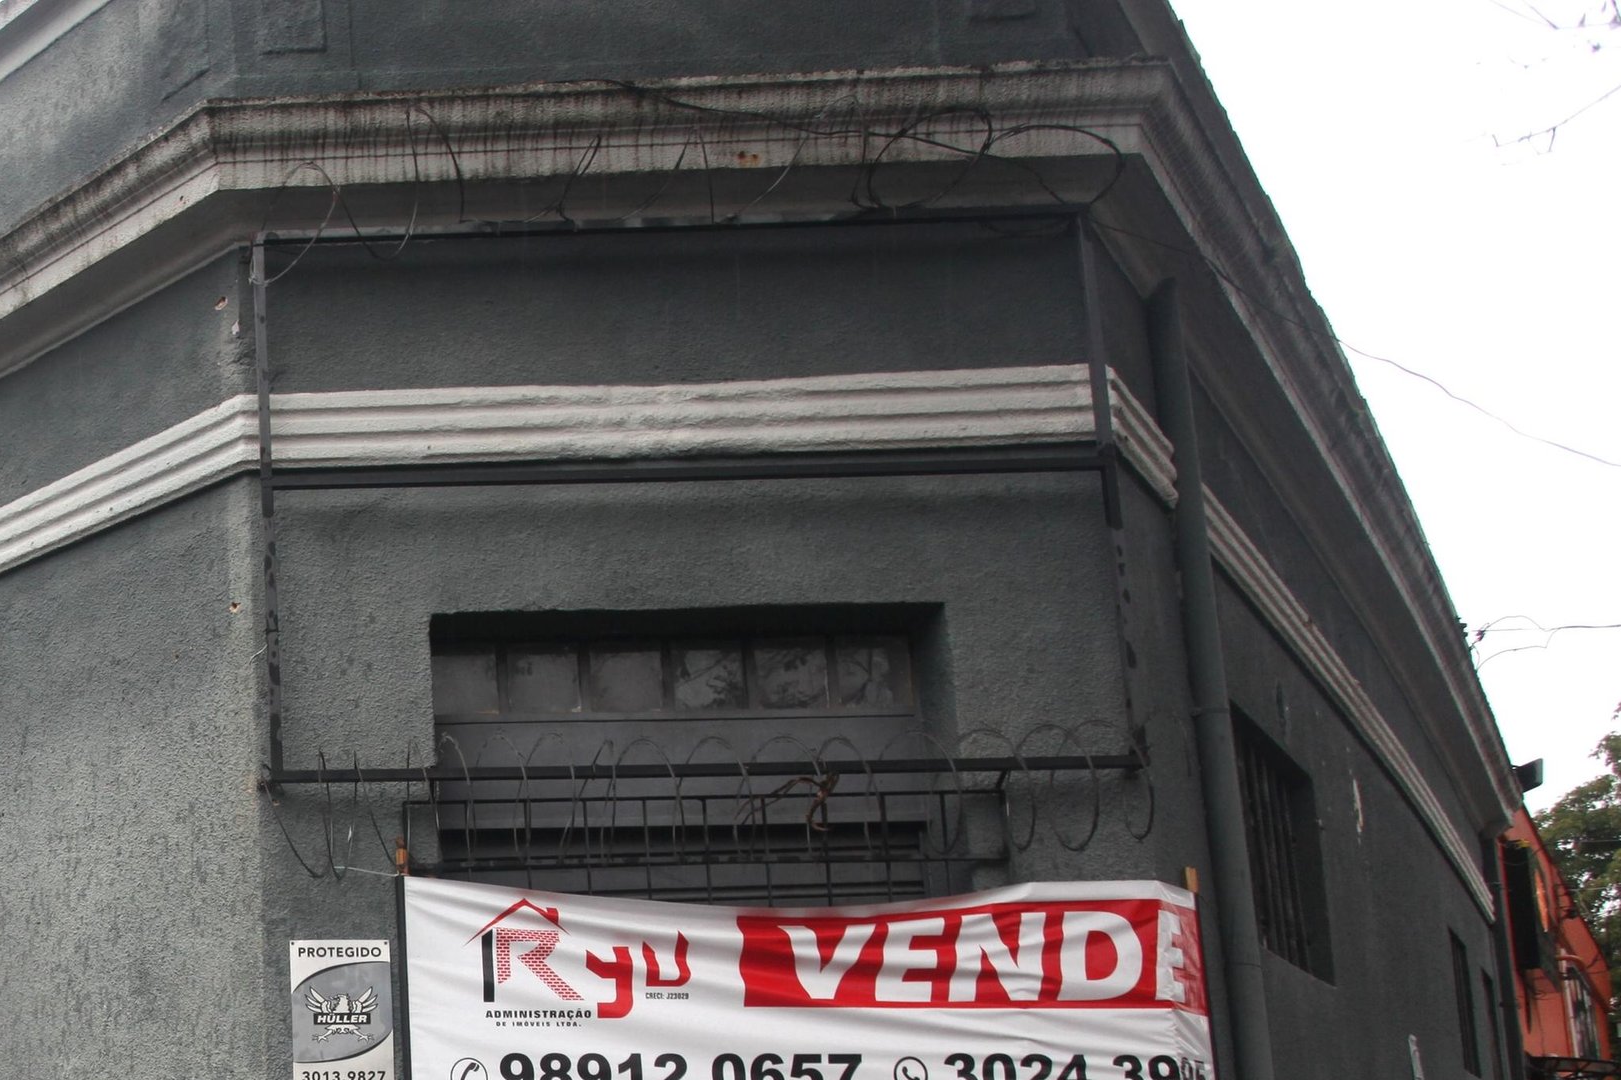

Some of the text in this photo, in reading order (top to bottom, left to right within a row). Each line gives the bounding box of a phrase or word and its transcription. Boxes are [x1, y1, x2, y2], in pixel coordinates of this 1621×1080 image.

[298, 947, 382, 958] PROTEGIDO
[777, 910, 1187, 1003] VENDE
[317, 1013, 368, 1024] HÜLLER
